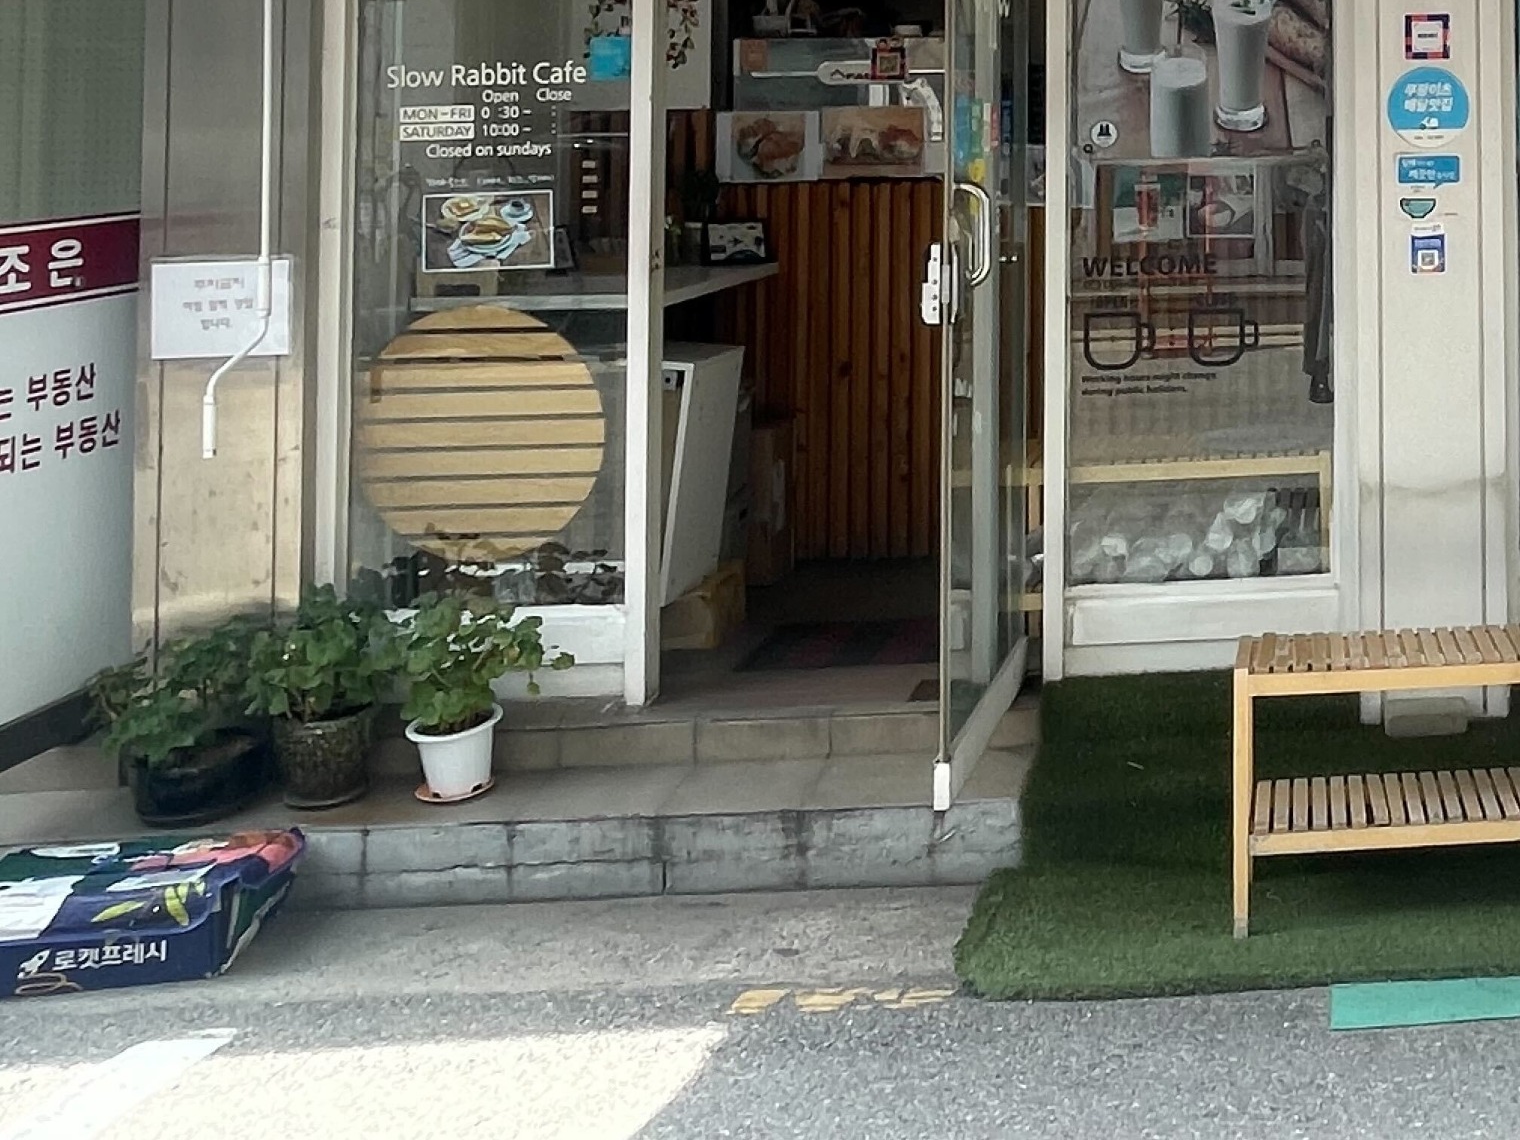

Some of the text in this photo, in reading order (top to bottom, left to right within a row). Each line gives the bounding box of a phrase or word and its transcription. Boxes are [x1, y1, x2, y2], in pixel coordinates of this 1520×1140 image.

[387, 60, 588, 89] Slow Rabbit Cafe
[482, 87, 572, 104] Open Close
[402, 124, 472, 139] SATURDAY
[482, 124, 519, 137] 10:00
[426, 141, 552, 158] Closed on sundays
[1083, 254, 1218, 278] WELCOME
[27, 362, 96, 412] 부동산
[54, 409, 121, 460] 부동산
[52, 940, 167, 971] 로켓프레시
